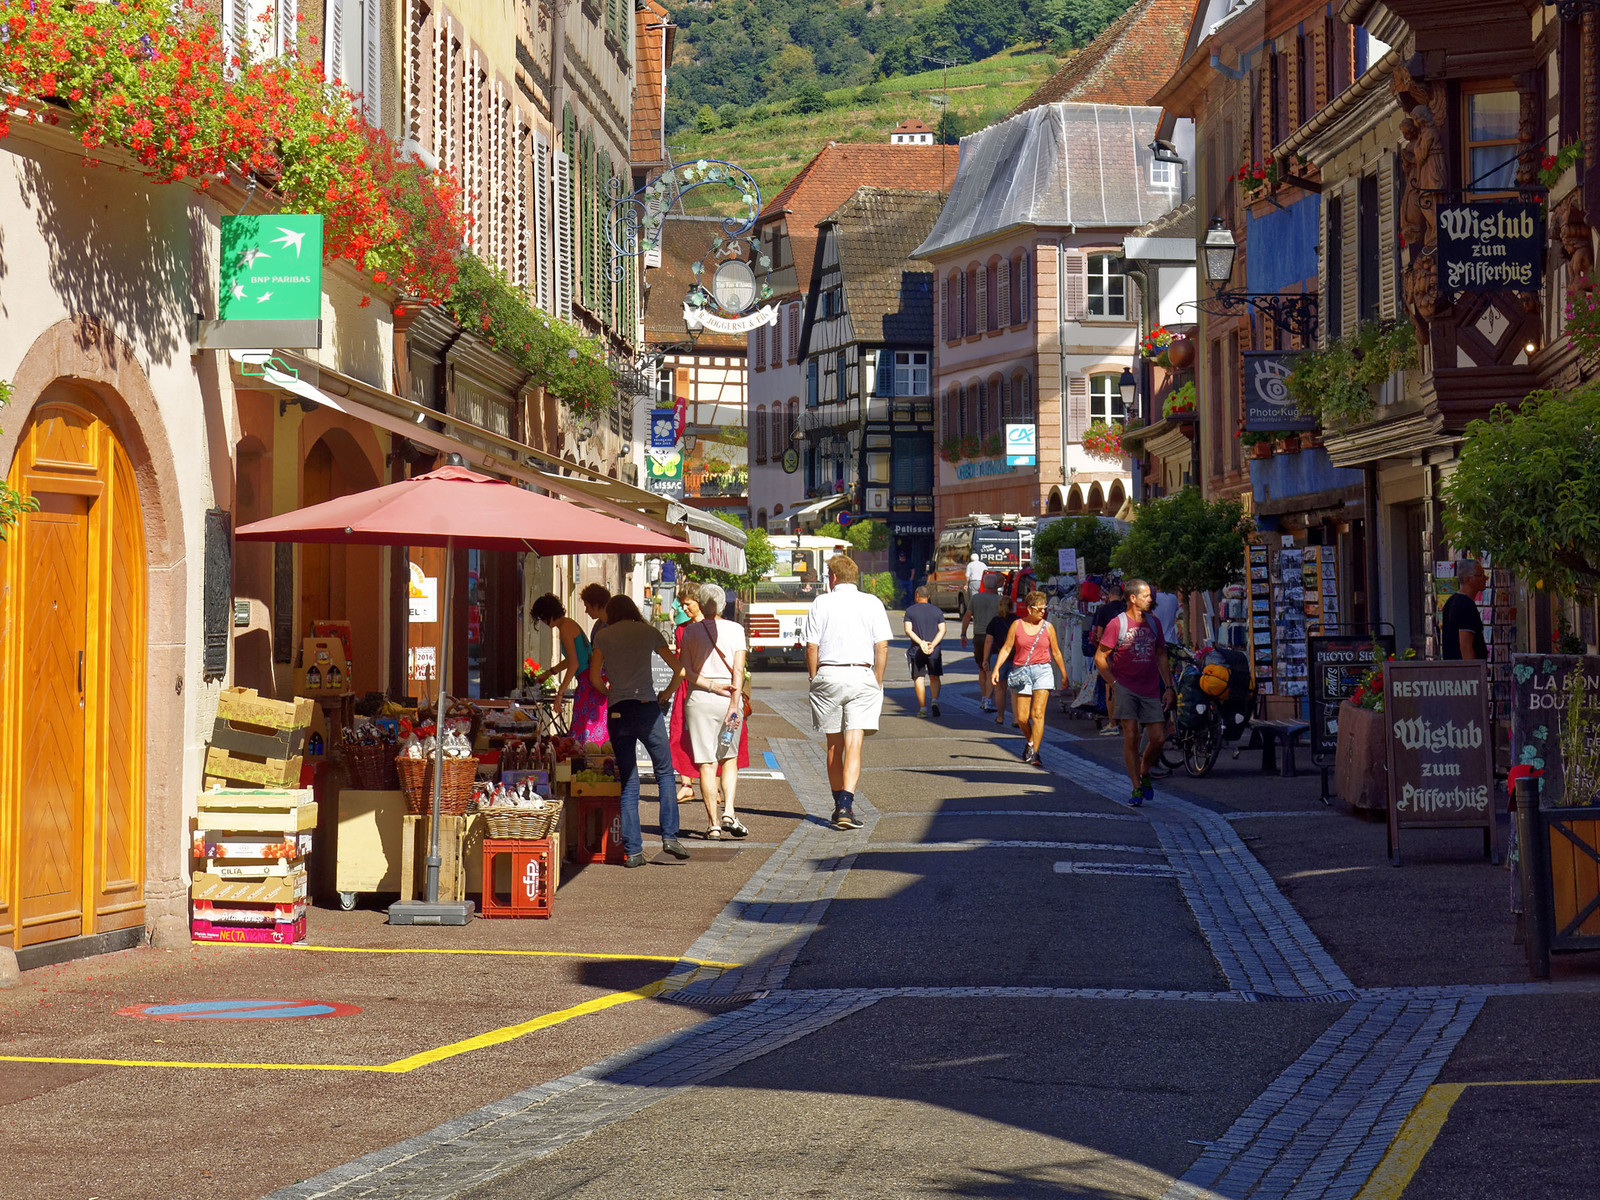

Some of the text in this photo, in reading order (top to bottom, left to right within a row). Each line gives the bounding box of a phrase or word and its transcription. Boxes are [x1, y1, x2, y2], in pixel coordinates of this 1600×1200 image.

[1440, 207, 1534, 243] Wistub
[1471, 243, 1507, 257] zum
[1446, 260, 1532, 288] Pfifferhüs
[706, 317, 746, 331] JOGGERST
[1250, 408, 1300, 418] Photo Kug
[654, 482, 682, 490] LISSAC
[1317, 651, 1354, 662] PHOTO
[1327, 667, 1338, 696] PRINTS
[1393, 680, 1479, 697] RESTAURANT
[1533, 674, 1557, 690] LA
[1393, 715, 1482, 753] Wistub
[1421, 763, 1461, 777] zum
